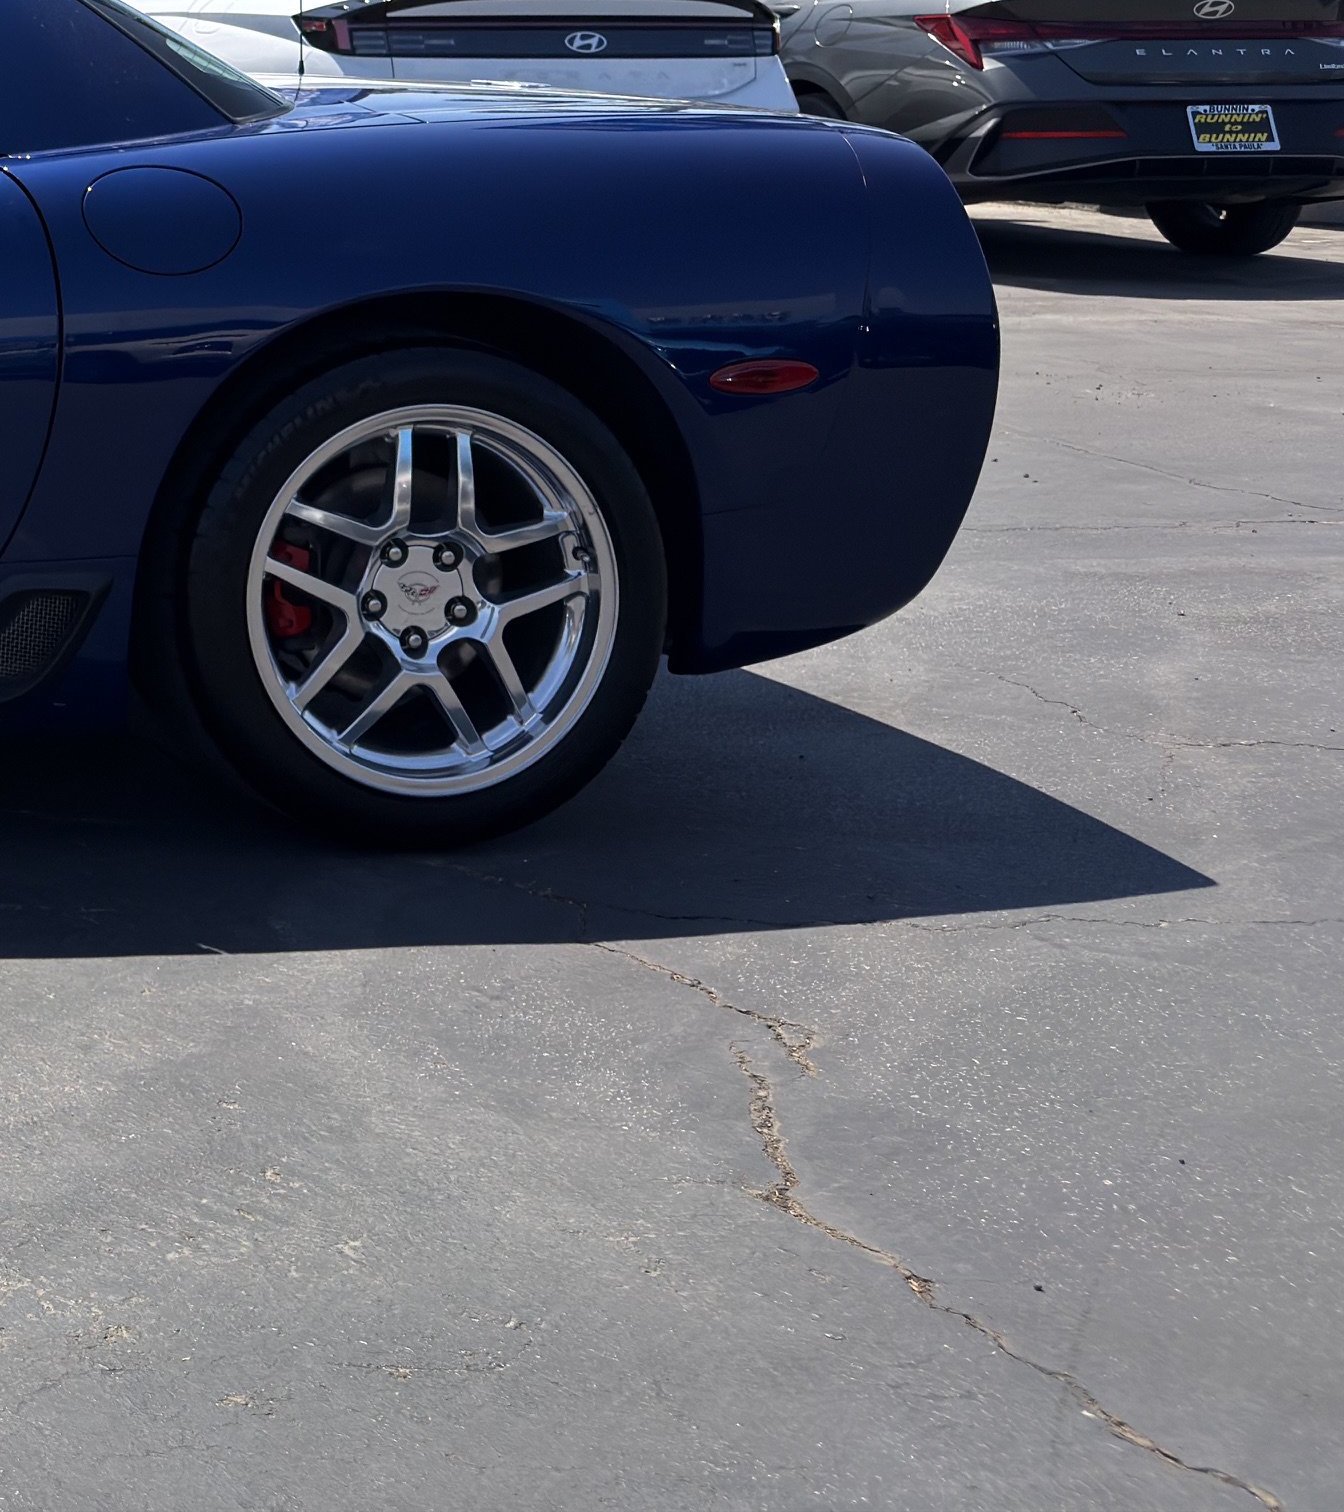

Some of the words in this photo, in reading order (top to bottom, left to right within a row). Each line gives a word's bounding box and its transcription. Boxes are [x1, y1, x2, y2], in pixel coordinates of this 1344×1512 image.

[1135, 48, 1295, 56] ELANTRA
[1209, 105, 1250, 113] BUNNIN
[1194, 114, 1267, 123] RUNNIN'
[1198, 133, 1268, 142] BUNNIN
